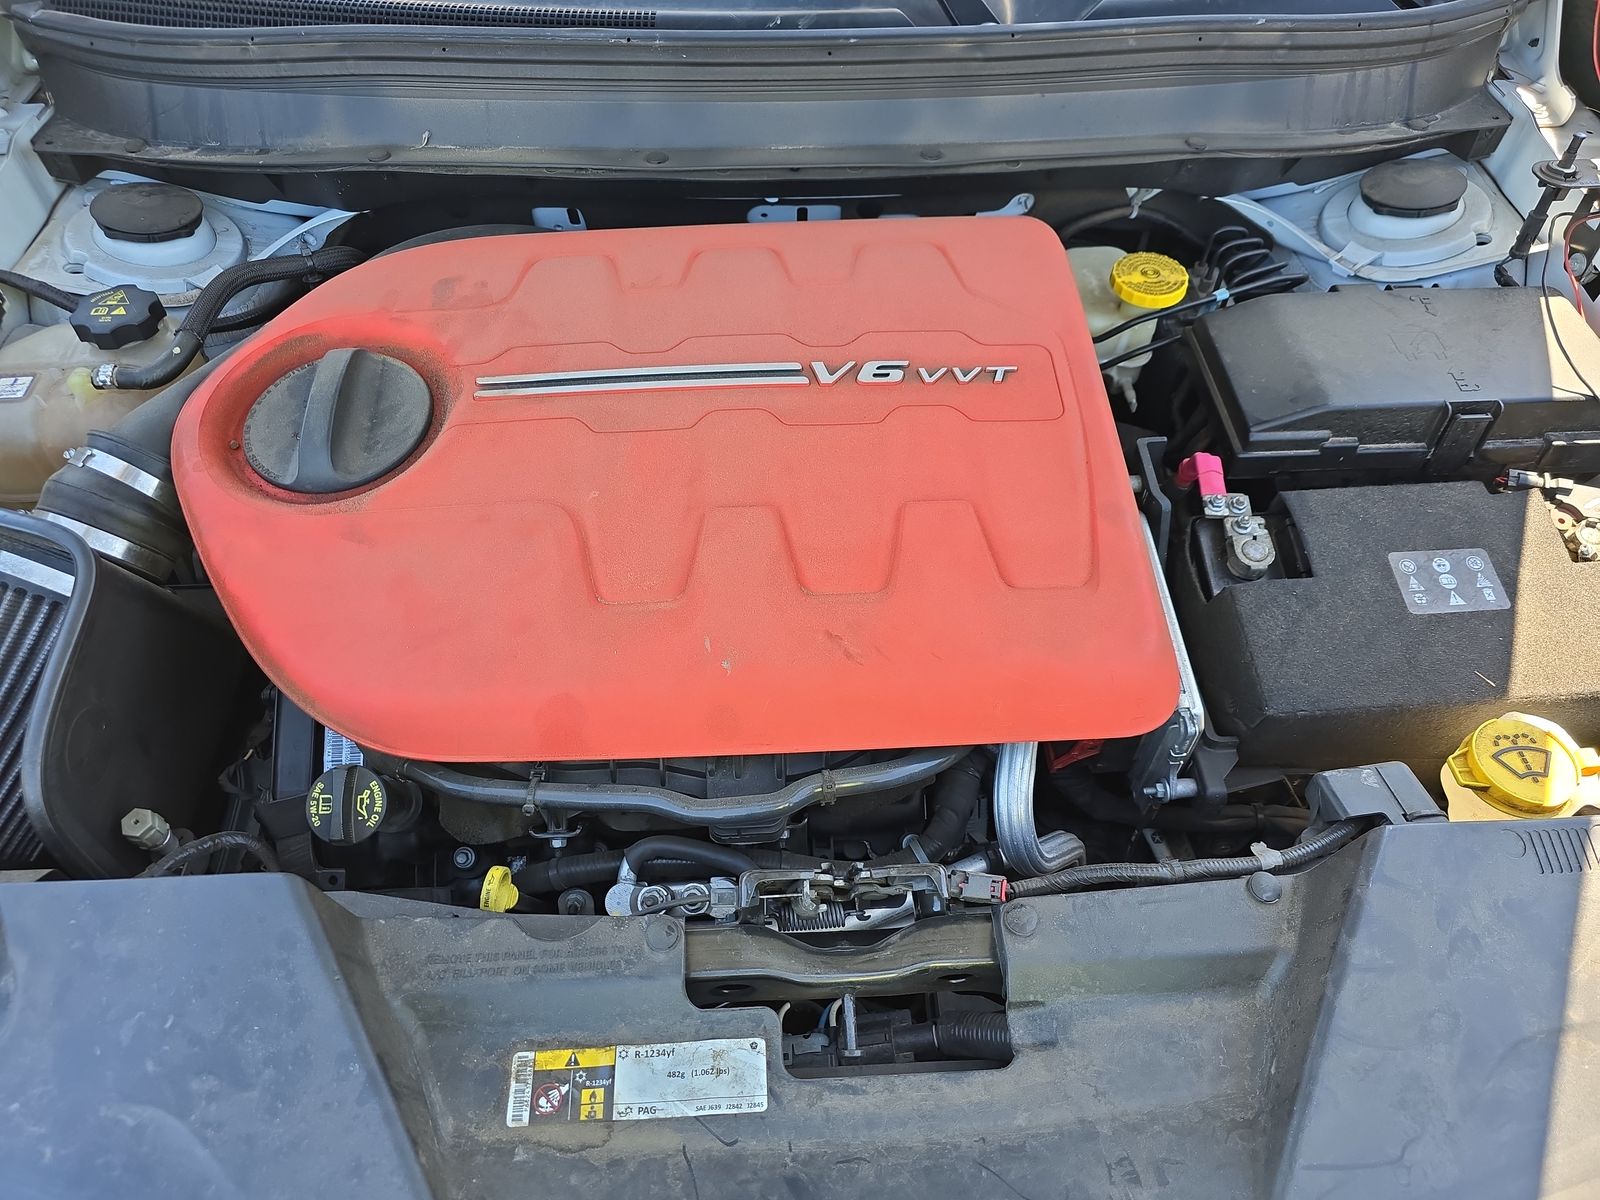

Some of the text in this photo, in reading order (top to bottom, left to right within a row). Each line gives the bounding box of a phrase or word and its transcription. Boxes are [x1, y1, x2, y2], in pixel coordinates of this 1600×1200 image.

[810, 360, 1018, 387] V6 VVT
[310, 782, 325, 827] SAE 5W-20
[366, 780, 383, 828] ENGINE OIL
[634, 1047, 675, 1060] R-1234yf
[666, 1069, 686, 1080] 482g
[691, 1067, 715, 1079] (1.062
[585, 1077, 612, 1087] R-1234yf
[708, 1103, 722, 1112] J639
[725, 1102, 743, 1110] J2842
[746, 1101, 765, 1110] J2845
